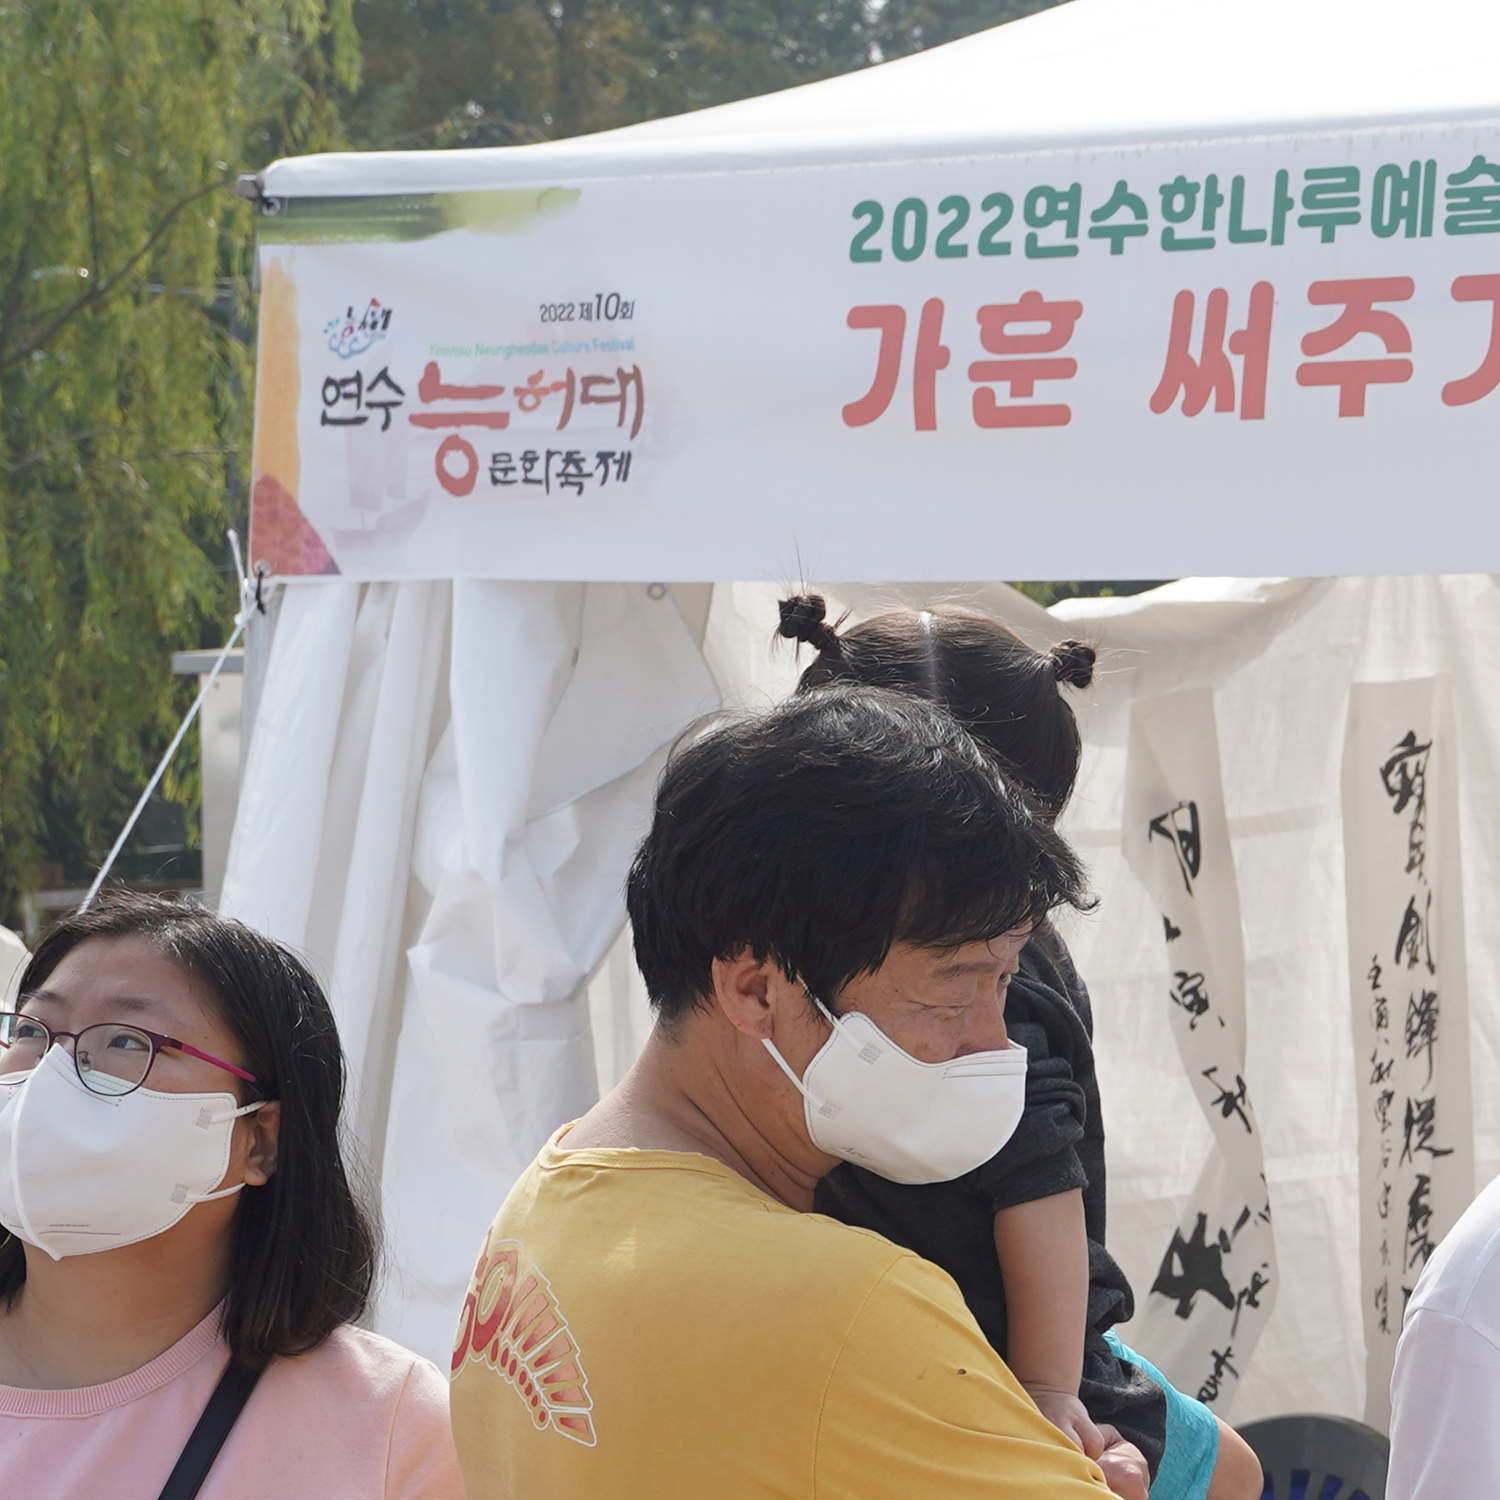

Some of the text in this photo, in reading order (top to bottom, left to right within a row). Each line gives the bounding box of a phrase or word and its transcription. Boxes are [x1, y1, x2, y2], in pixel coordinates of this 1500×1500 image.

[539, 292, 635, 323] 2022 제10회
[842, 290, 1084, 432] 가훈
[320, 360, 644, 497] 연수 능허대
[488, 448, 632, 496] 문화축제
